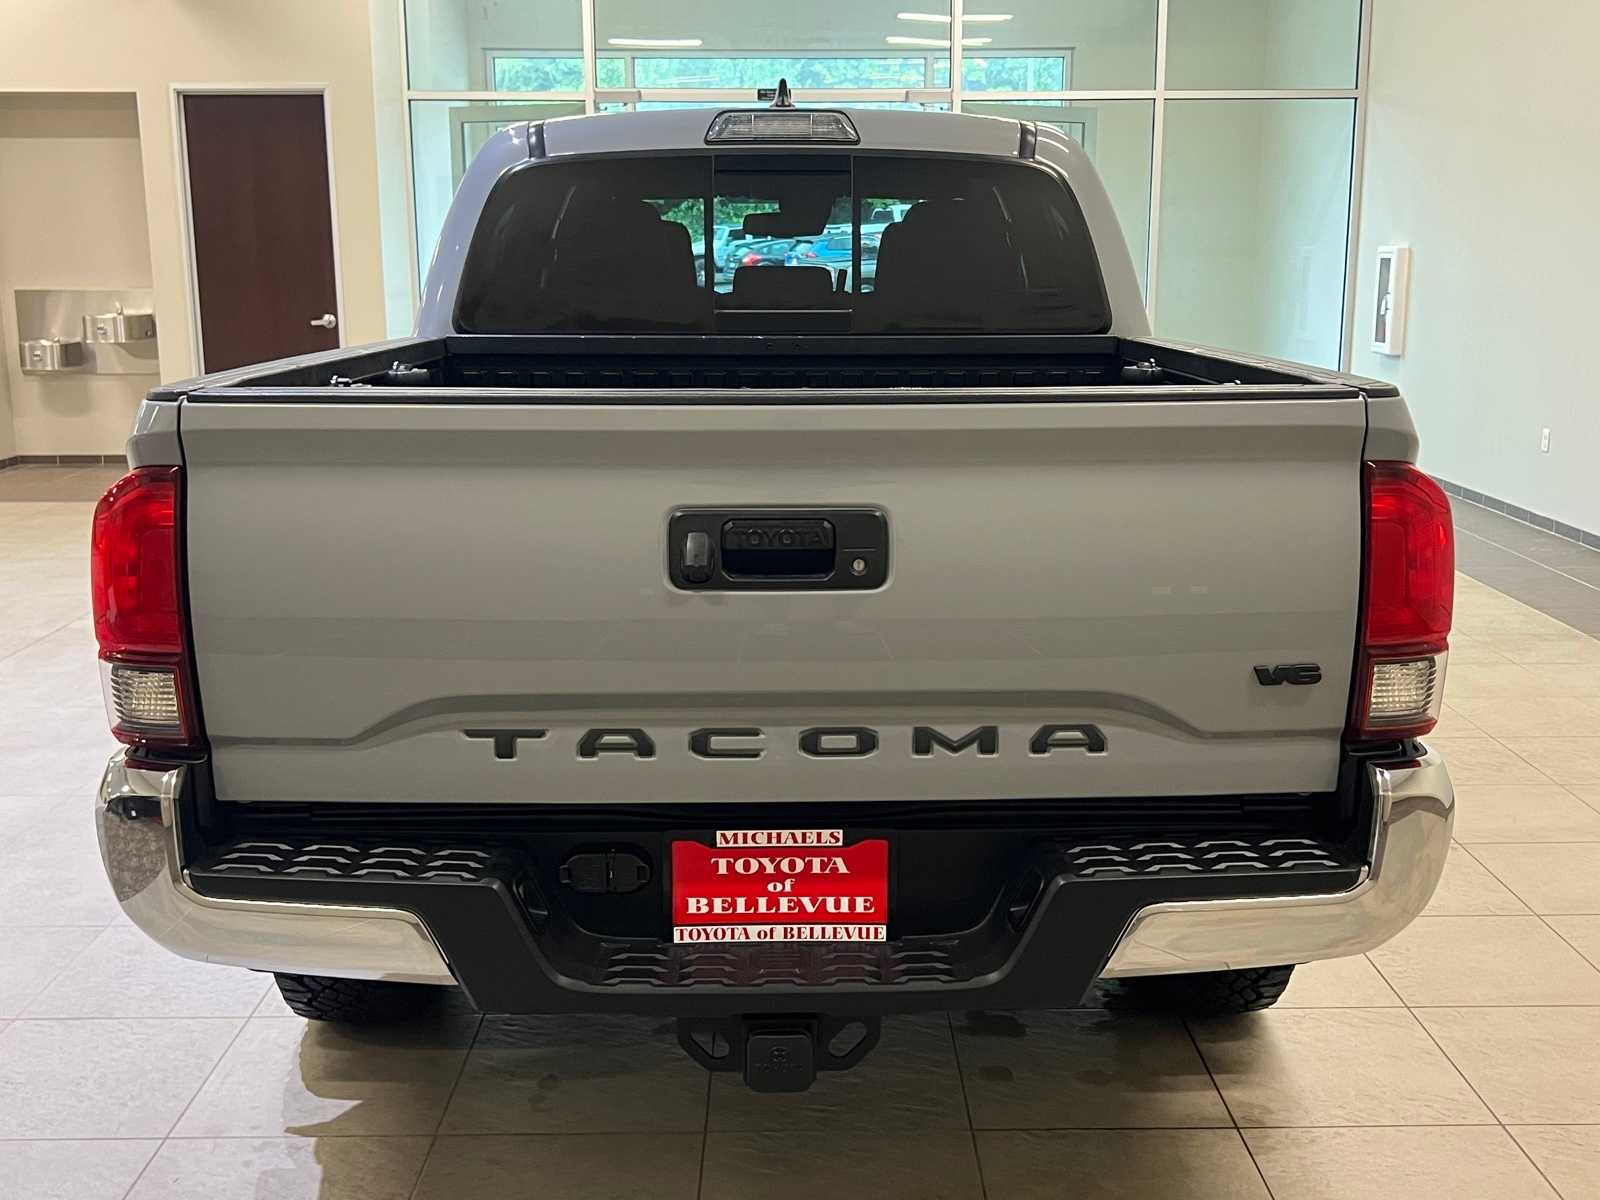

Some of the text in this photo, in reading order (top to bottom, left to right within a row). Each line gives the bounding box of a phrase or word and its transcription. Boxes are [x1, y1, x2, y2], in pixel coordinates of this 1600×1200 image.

[734, 527, 826, 545] TOYOTA
[1254, 664, 1322, 686] V6
[463, 723, 1108, 759] TACOMA
[719, 831, 841, 845] MICHAELS
[711, 857, 851, 875] TOYOTA
[767, 878, 795, 892] of
[686, 896, 875, 914] BELLEVUE
[676, 925, 885, 942] TOYOTA of BELLEVUE
